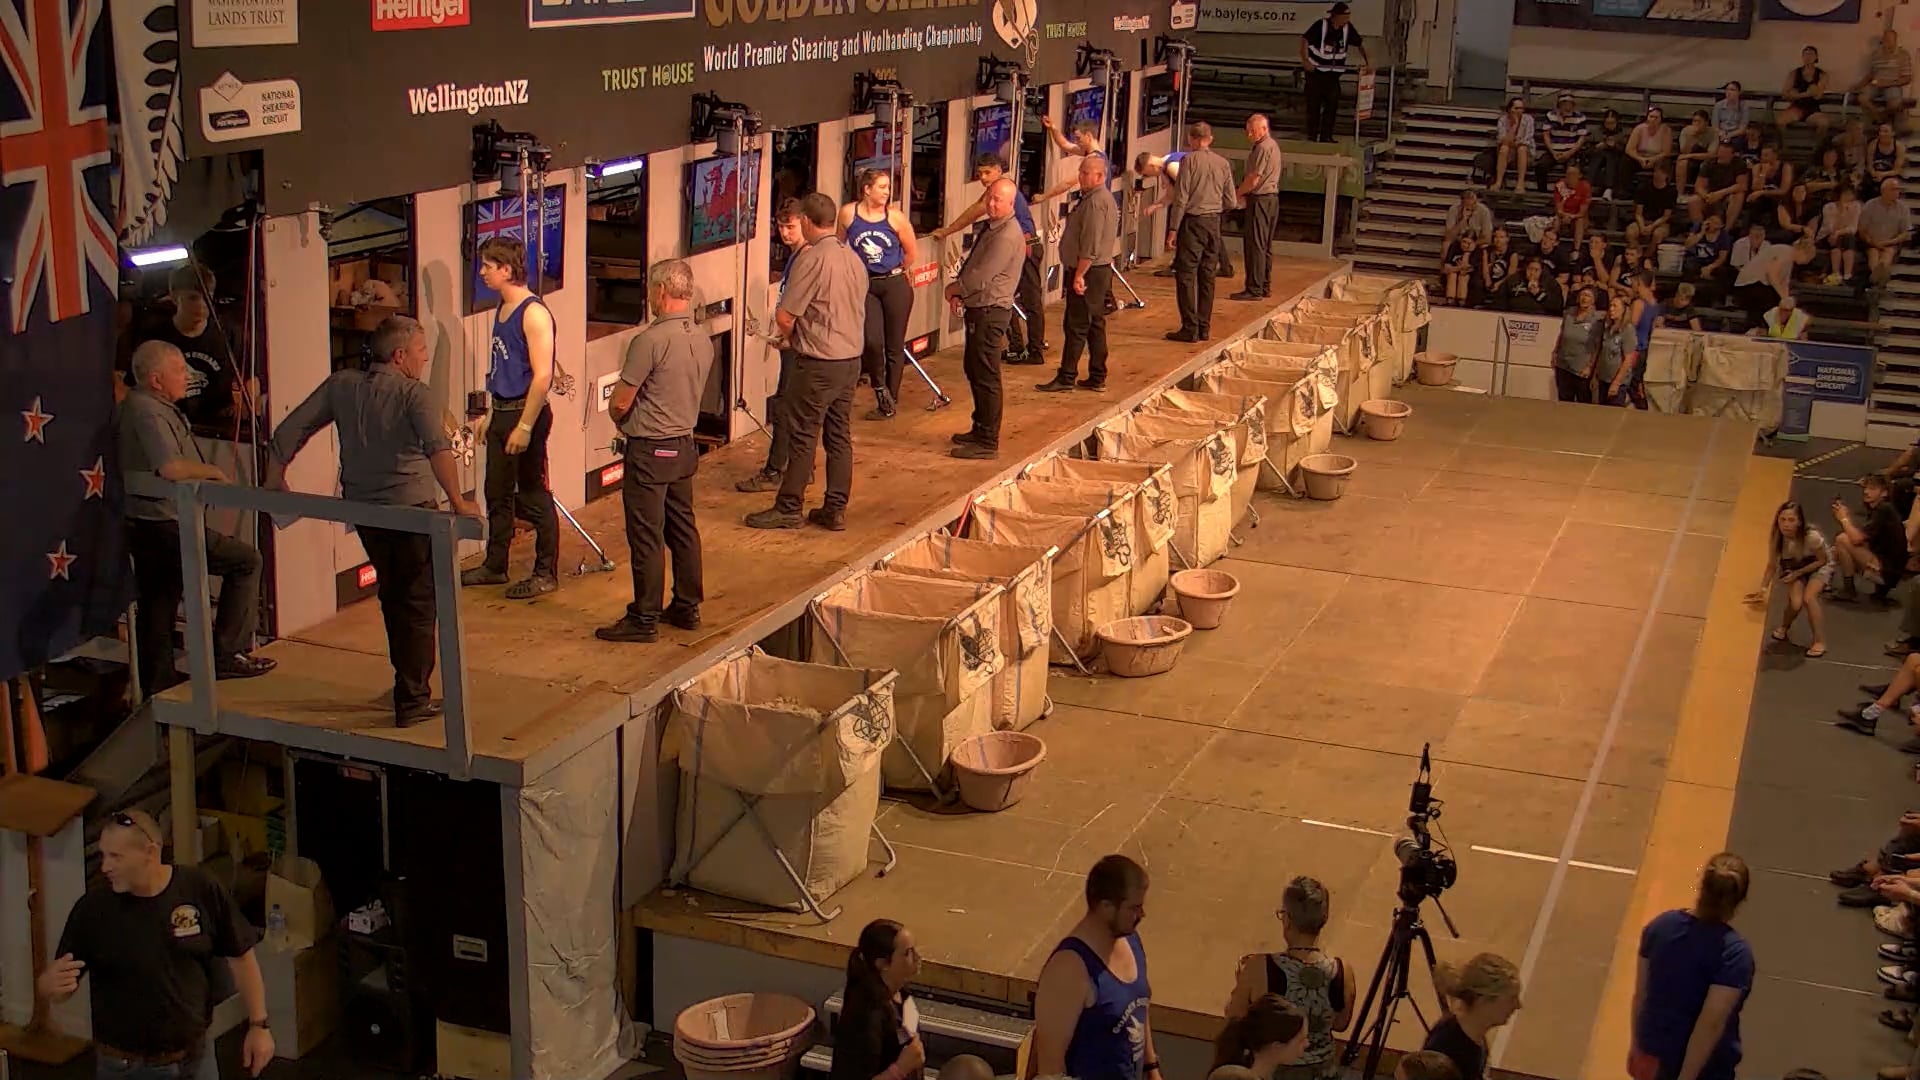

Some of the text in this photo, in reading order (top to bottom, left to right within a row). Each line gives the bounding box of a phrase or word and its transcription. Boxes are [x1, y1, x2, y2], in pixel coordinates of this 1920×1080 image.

[208, 10, 285, 26] LANDS TRUST
[703, 21, 982, 73] World Premier Shearing and Woolhandling Championship
[602, 62, 695, 91] TRUST HOUSE
[261, 90, 295, 101] NATIONAL
[408, 79, 529, 115] WellingtonNZ
[262, 101, 296, 113] SHEARING
[262, 114, 289, 125] CIRCUIT
[1817, 366, 1857, 376] NATIONAL
